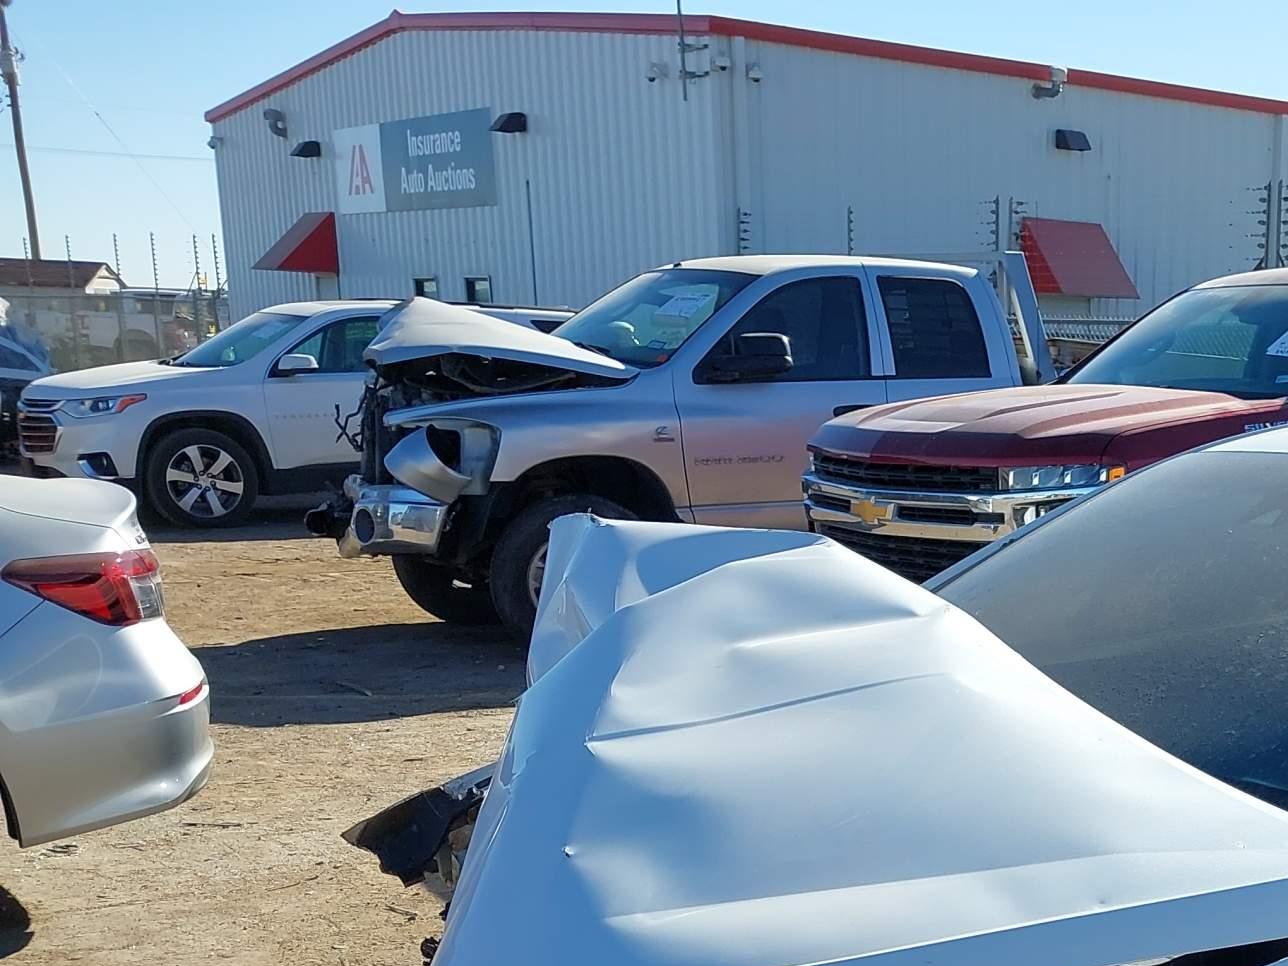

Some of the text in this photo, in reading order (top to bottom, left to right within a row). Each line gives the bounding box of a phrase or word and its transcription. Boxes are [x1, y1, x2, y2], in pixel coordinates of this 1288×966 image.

[407, 129, 461, 157] Insurance
[401, 162, 476, 194] Auto Auctions
